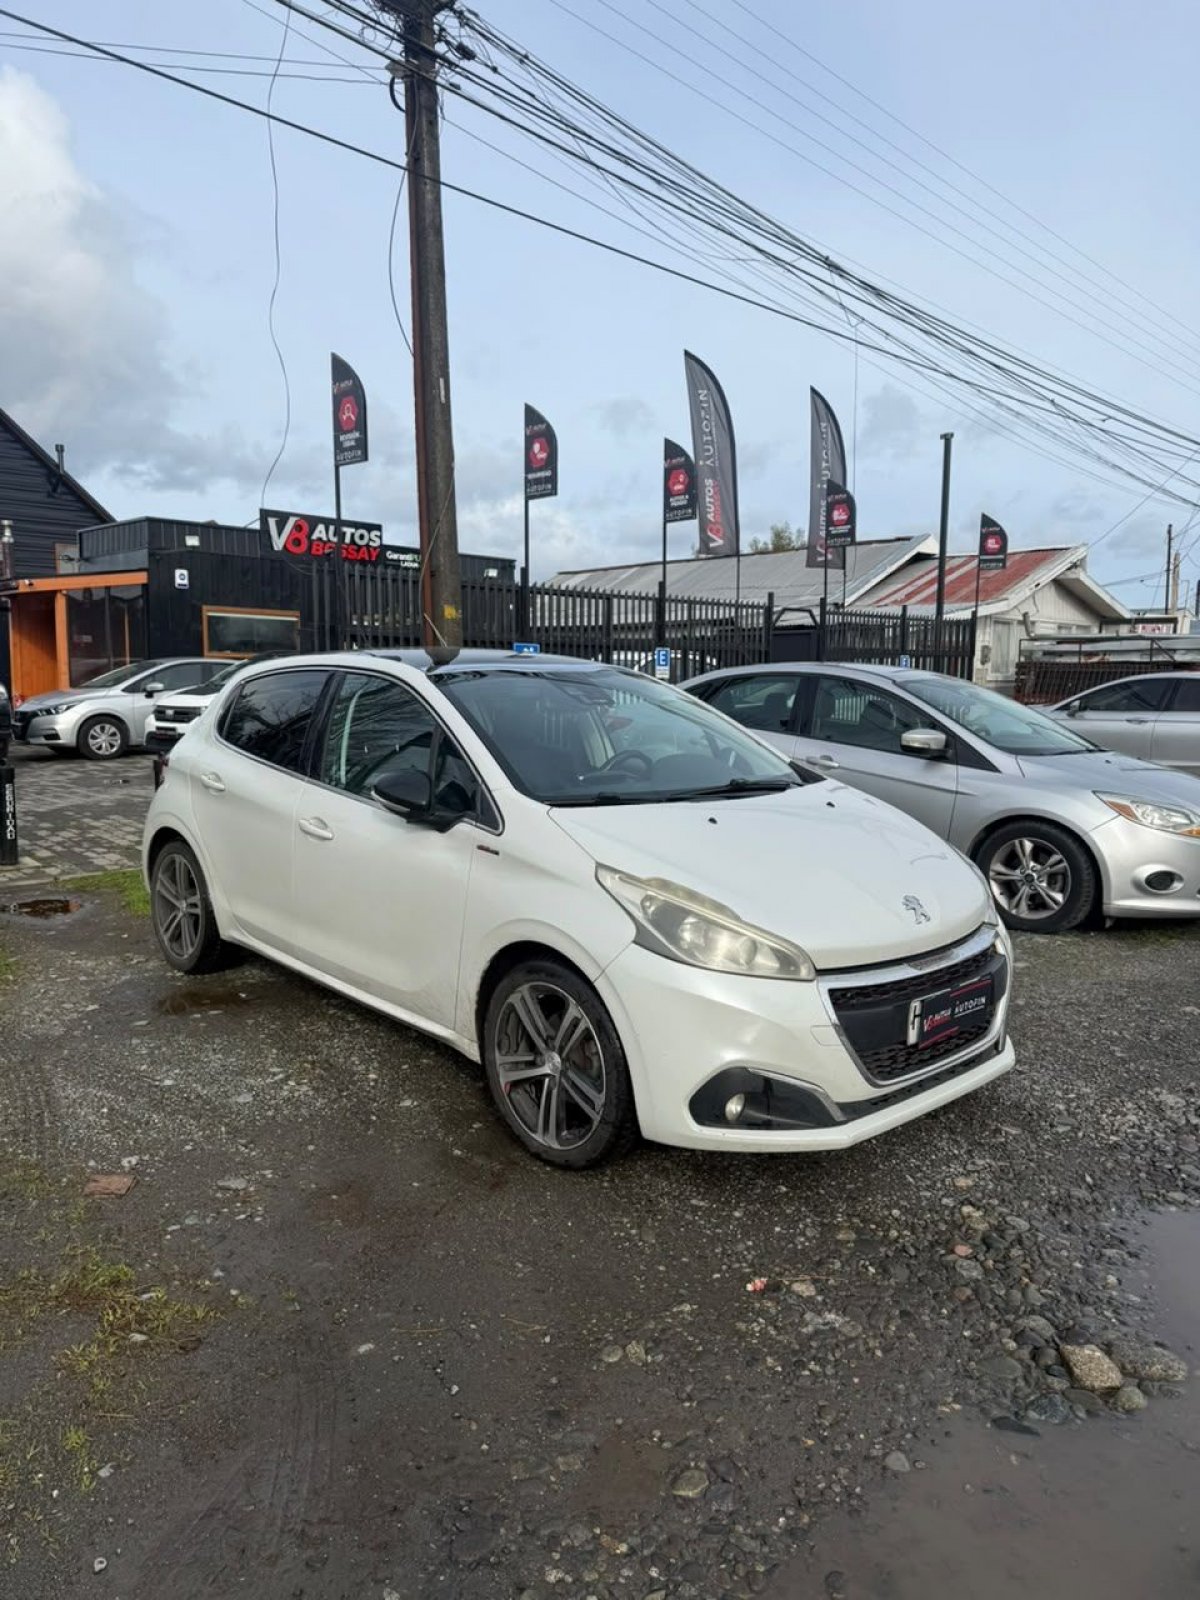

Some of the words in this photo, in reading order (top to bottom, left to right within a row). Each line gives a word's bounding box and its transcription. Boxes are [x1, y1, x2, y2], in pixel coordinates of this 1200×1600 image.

[704, 478, 715, 522] AUTOS
[267, 516, 310, 555] V8
[311, 524, 381, 547] AUTOS
